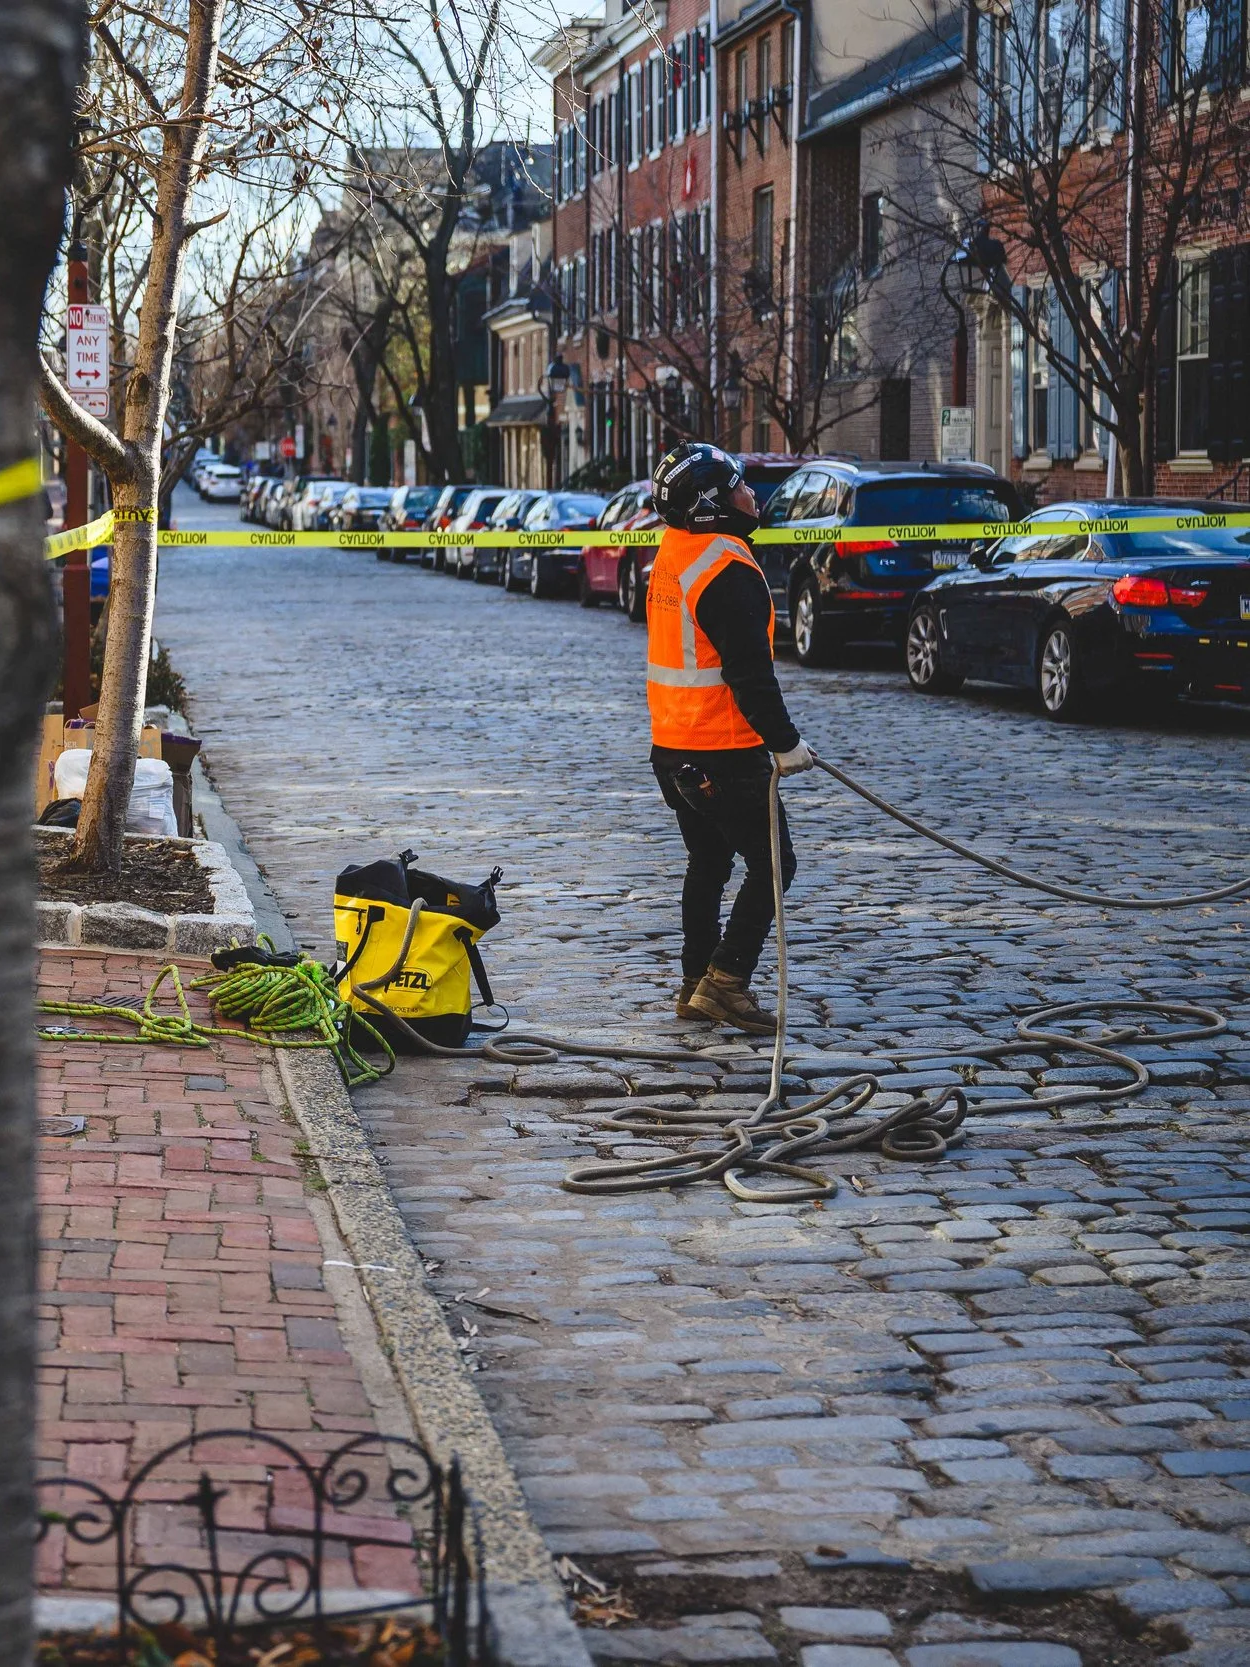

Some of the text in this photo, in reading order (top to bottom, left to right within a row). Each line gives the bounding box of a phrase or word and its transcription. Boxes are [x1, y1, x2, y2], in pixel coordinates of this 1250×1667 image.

[70, 310, 82, 326] NO
[76, 336, 99, 347] ANY
[76, 352, 100, 363] TIME
